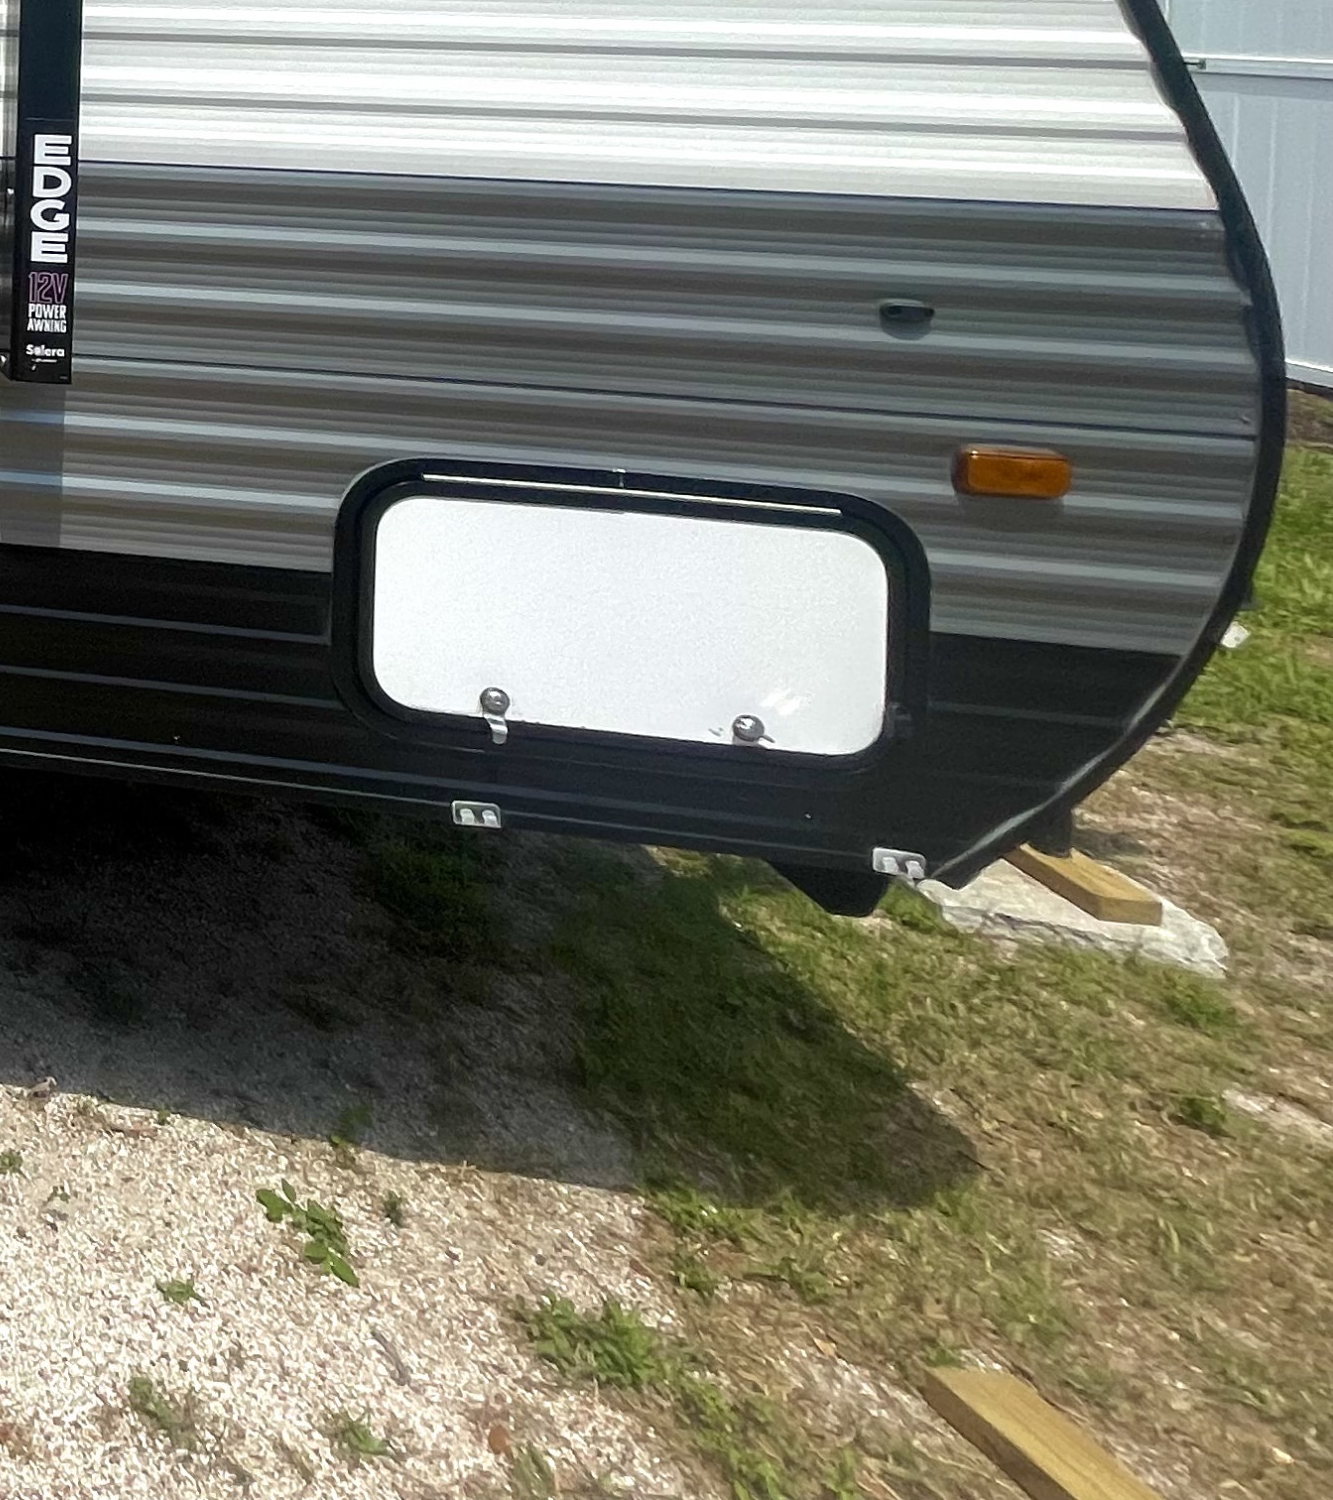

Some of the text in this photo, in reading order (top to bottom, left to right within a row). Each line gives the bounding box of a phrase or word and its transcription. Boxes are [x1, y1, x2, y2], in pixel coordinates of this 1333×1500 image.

[30, 134, 73, 264] EDGE
[28, 271, 69, 304] 12V
[28, 303, 67, 320] POWER
[27, 319, 67, 334] AWNING
